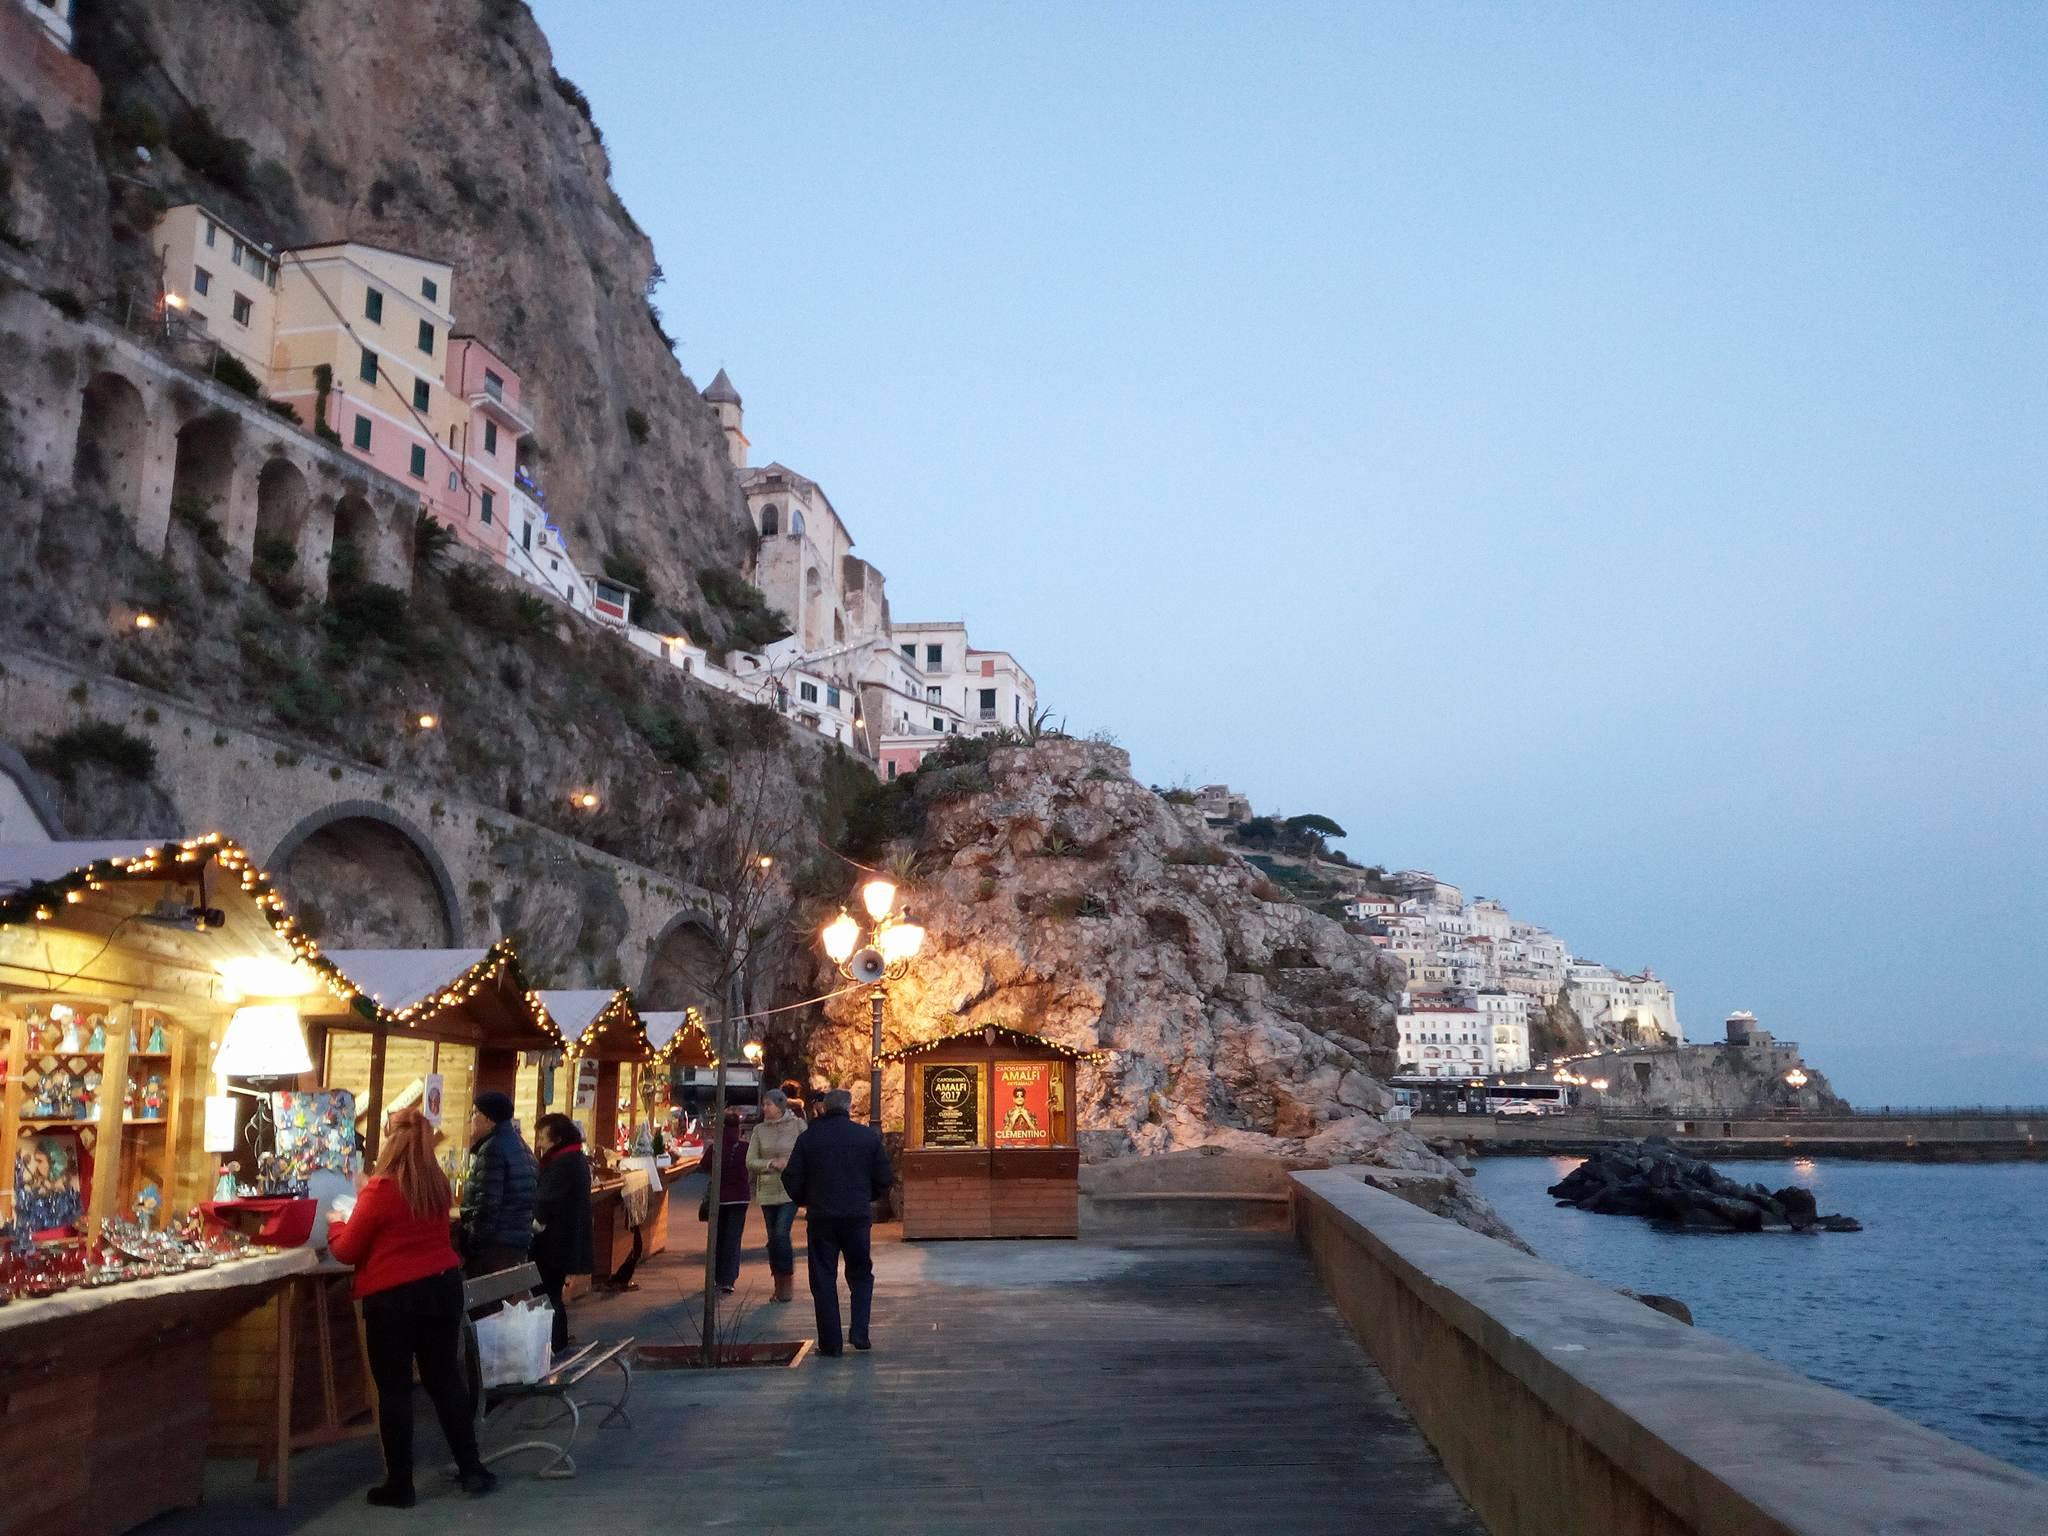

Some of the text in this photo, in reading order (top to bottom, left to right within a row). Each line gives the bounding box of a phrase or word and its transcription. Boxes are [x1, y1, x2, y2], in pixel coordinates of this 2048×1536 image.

[1001, 1071, 1040, 1081] AMALFI
[935, 1083, 967, 1092] AMALFI
[940, 1091, 961, 1099] 2017
[995, 1130, 1047, 1139] CLEMENTINO
